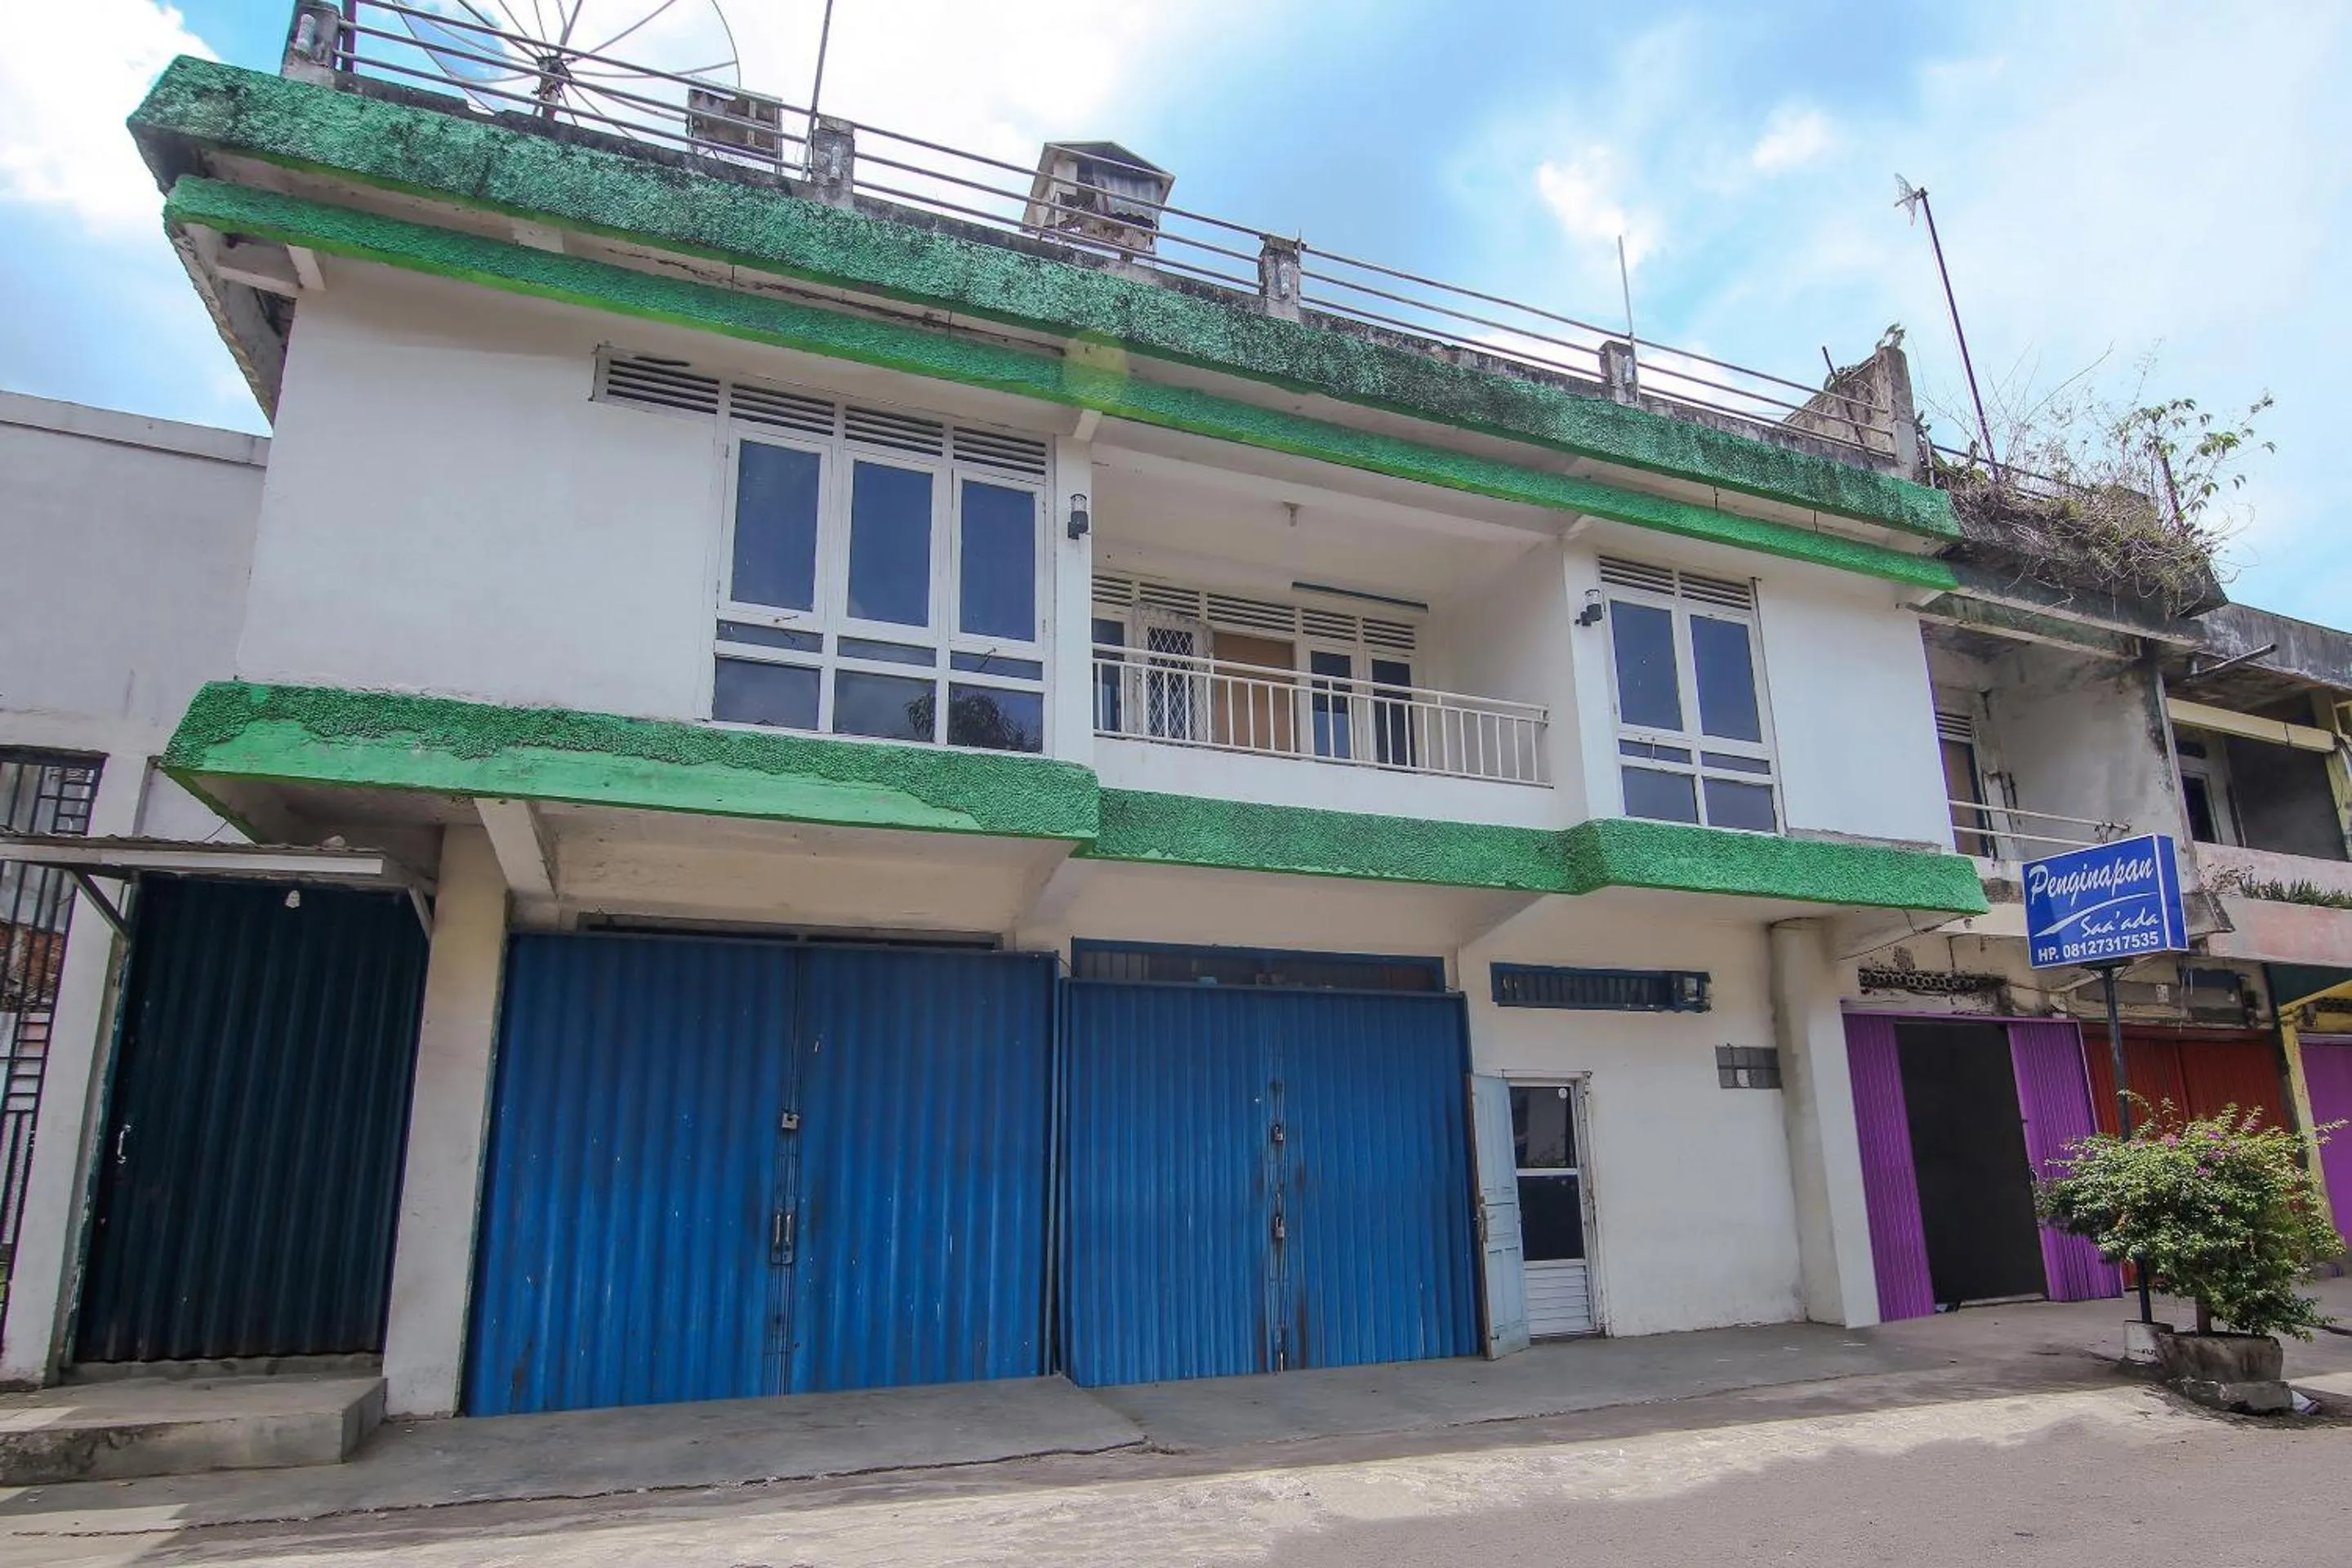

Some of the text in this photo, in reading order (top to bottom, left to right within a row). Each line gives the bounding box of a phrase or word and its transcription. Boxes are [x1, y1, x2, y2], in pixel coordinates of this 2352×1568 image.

[2029, 858, 2154, 906] Penginapan
[2081, 907, 2159, 938] Saa'ada
[2038, 931, 2158, 962] HP. 08127317535
